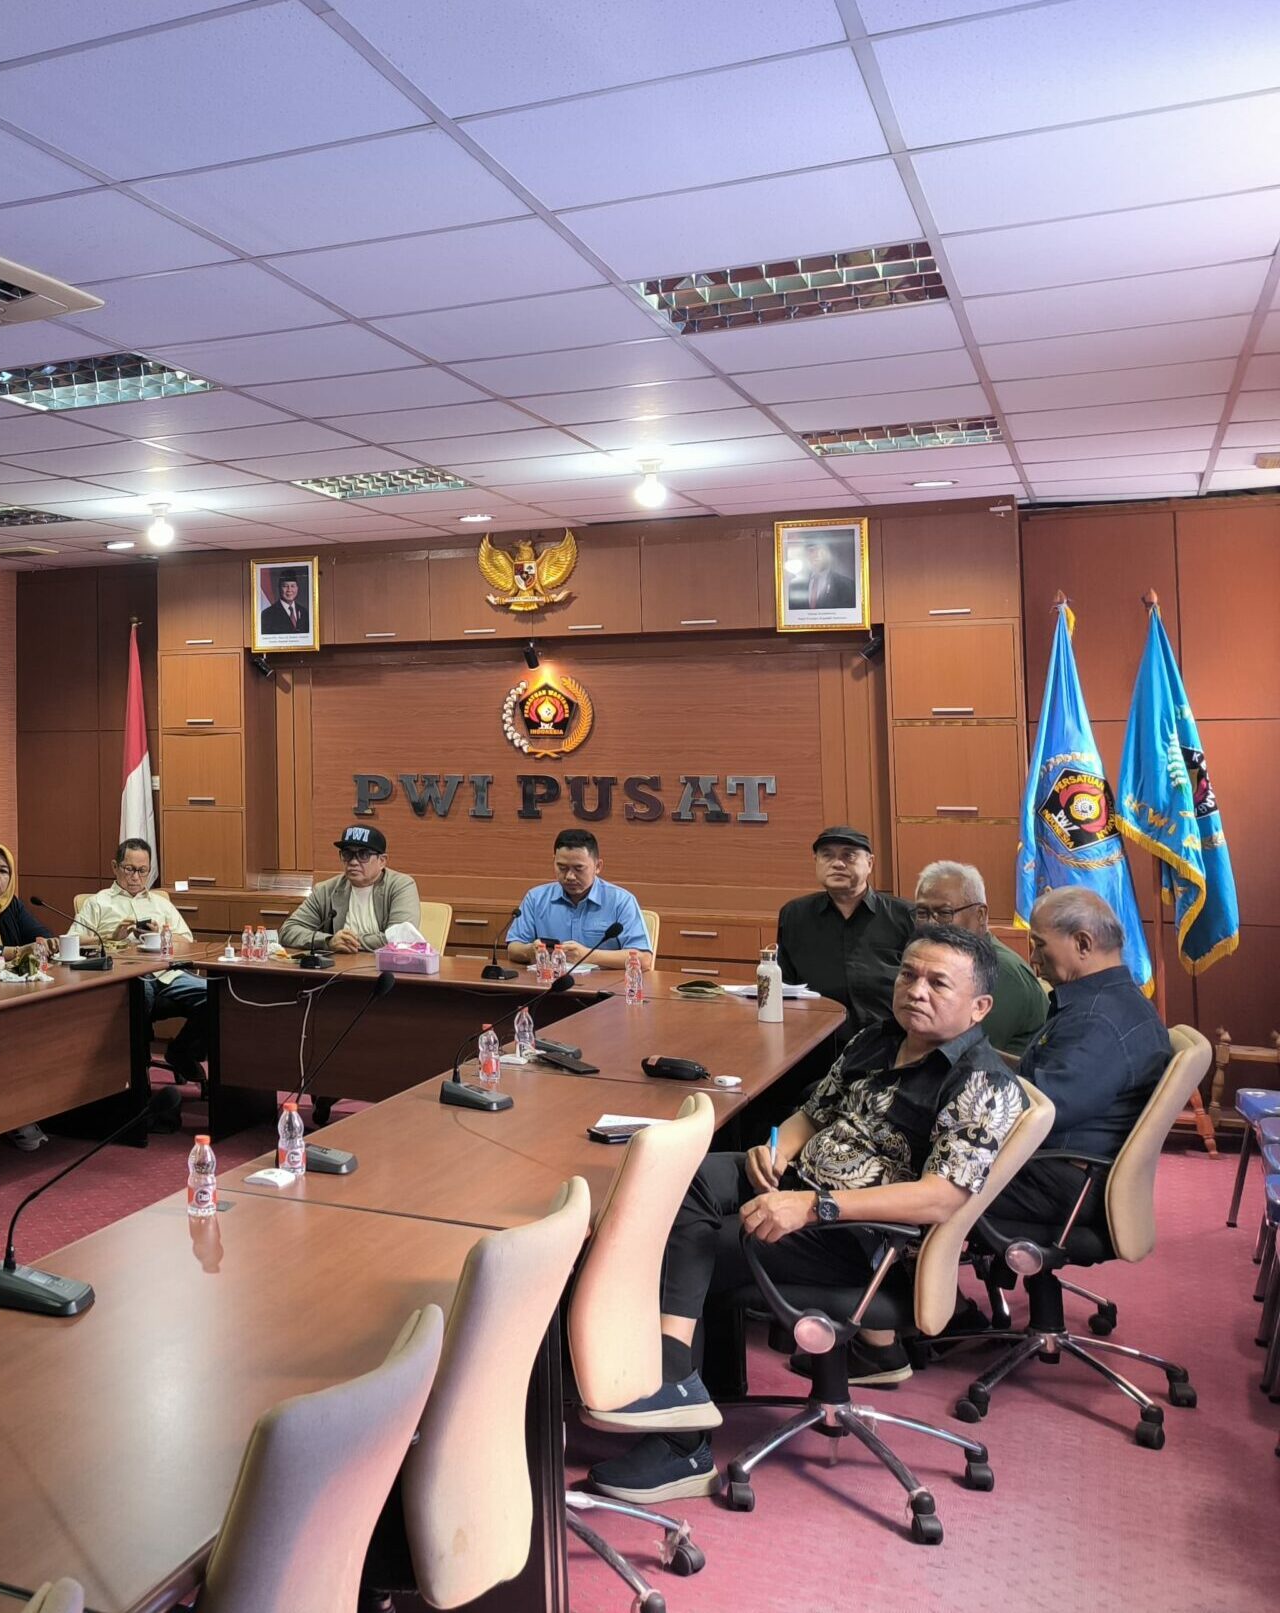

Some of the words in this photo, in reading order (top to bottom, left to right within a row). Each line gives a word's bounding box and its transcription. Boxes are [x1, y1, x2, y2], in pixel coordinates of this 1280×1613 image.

[352, 774, 493, 817] PWI
[516, 774, 777, 822] PUSAT
[1054, 774, 1105, 793] PERSATUAN
[345, 827, 370, 842] PWI
[1042, 808, 1075, 849] INDONESIA
